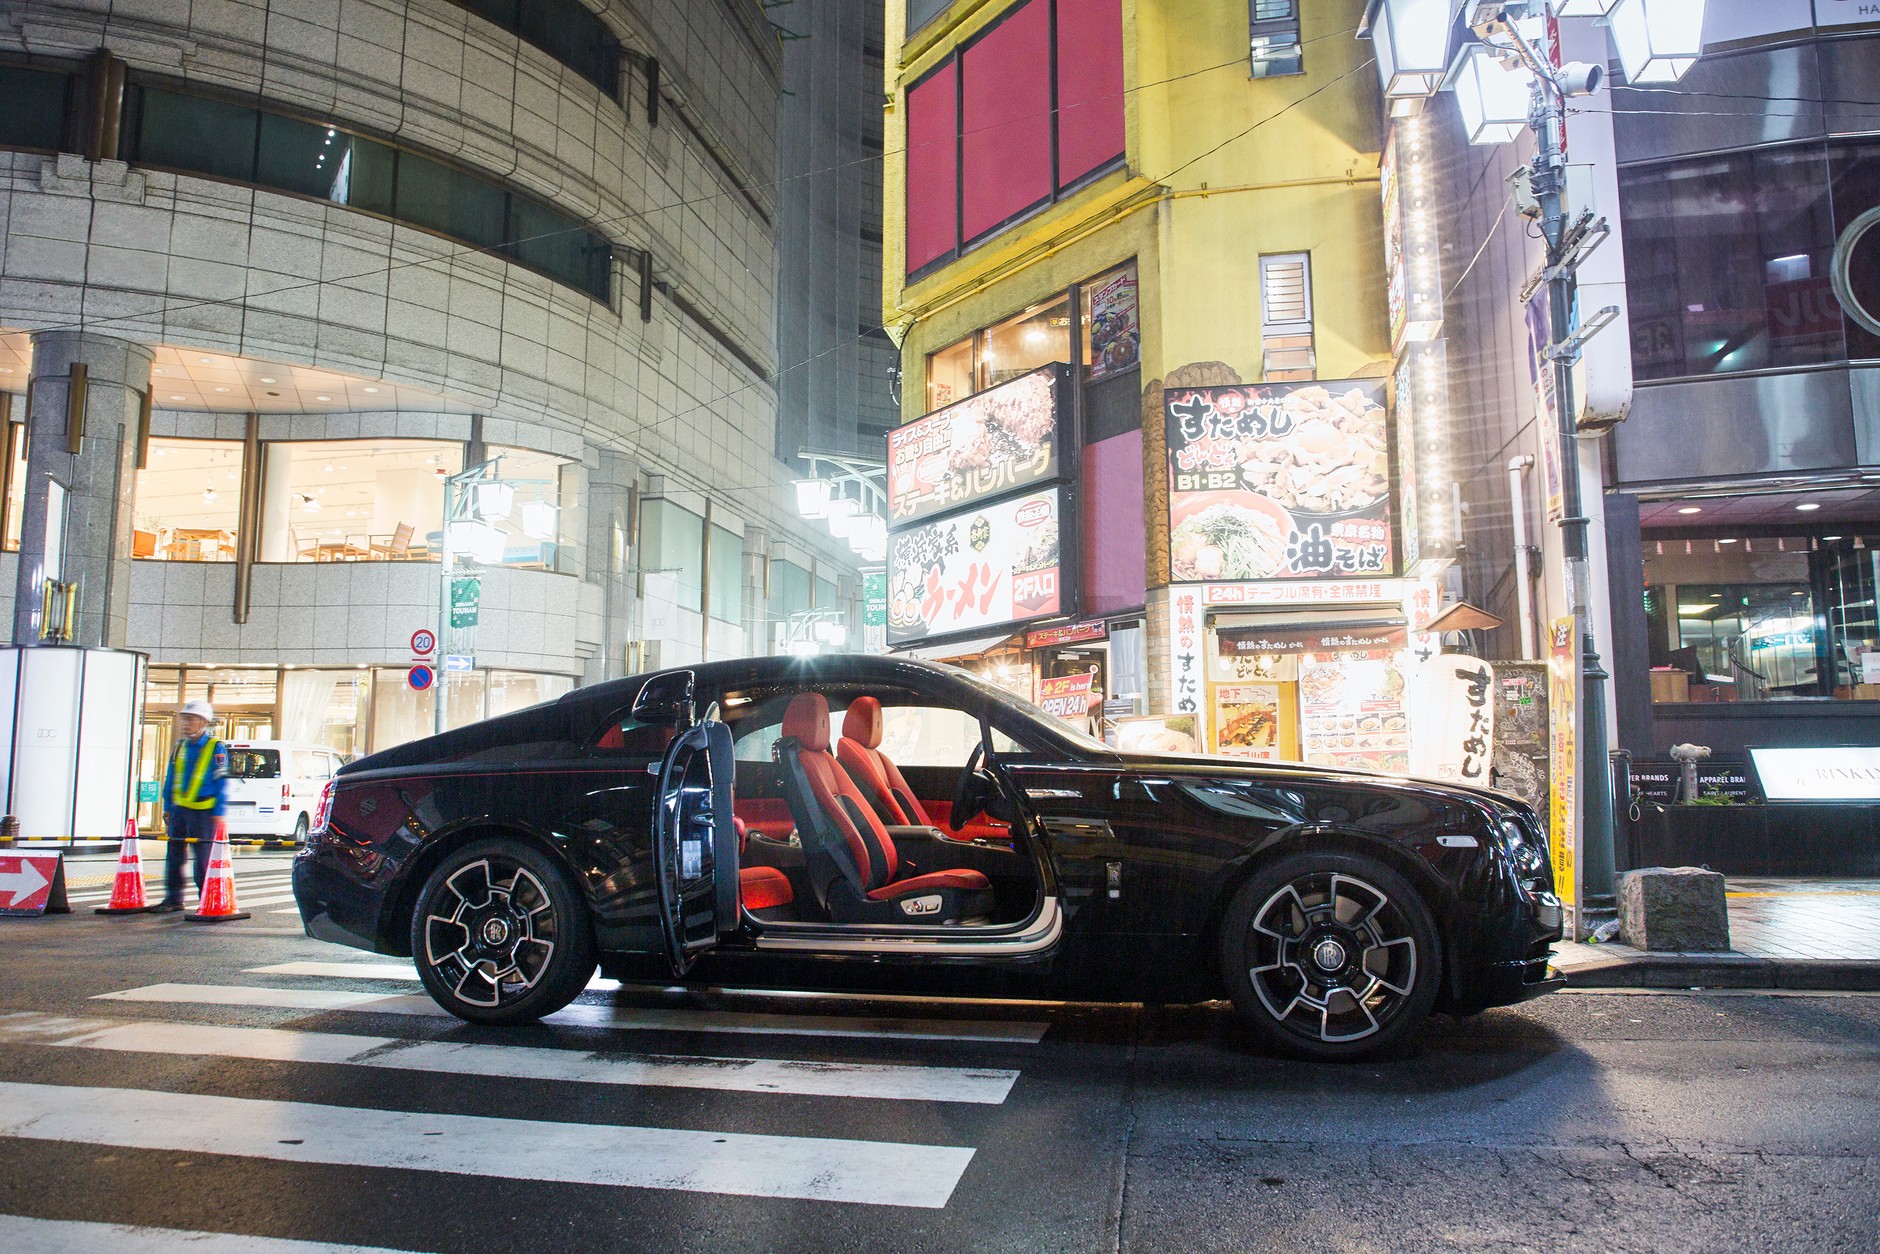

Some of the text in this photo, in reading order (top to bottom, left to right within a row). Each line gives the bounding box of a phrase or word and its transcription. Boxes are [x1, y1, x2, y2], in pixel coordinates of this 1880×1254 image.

[1171, 394, 1295, 441] すためし
[1177, 443, 1238, 470] どんどん
[893, 441, 1052, 519] ステーキ&ハンバーグ
[894, 523, 959, 569] 横浜家系
[1286, 524, 1387, 571] 油そば
[921, 561, 1003, 626] ラーメン
[1211, 587, 1243, 601] 24h
[415, 636, 431, 649] 20
[1054, 680, 1070, 694] 2F
[1219, 688, 1241, 699] 地下
[1041, 697, 1067, 716] OPEN
[1455, 664, 1492, 779] すためし
[1699, 776, 1728, 784] APPAREL
